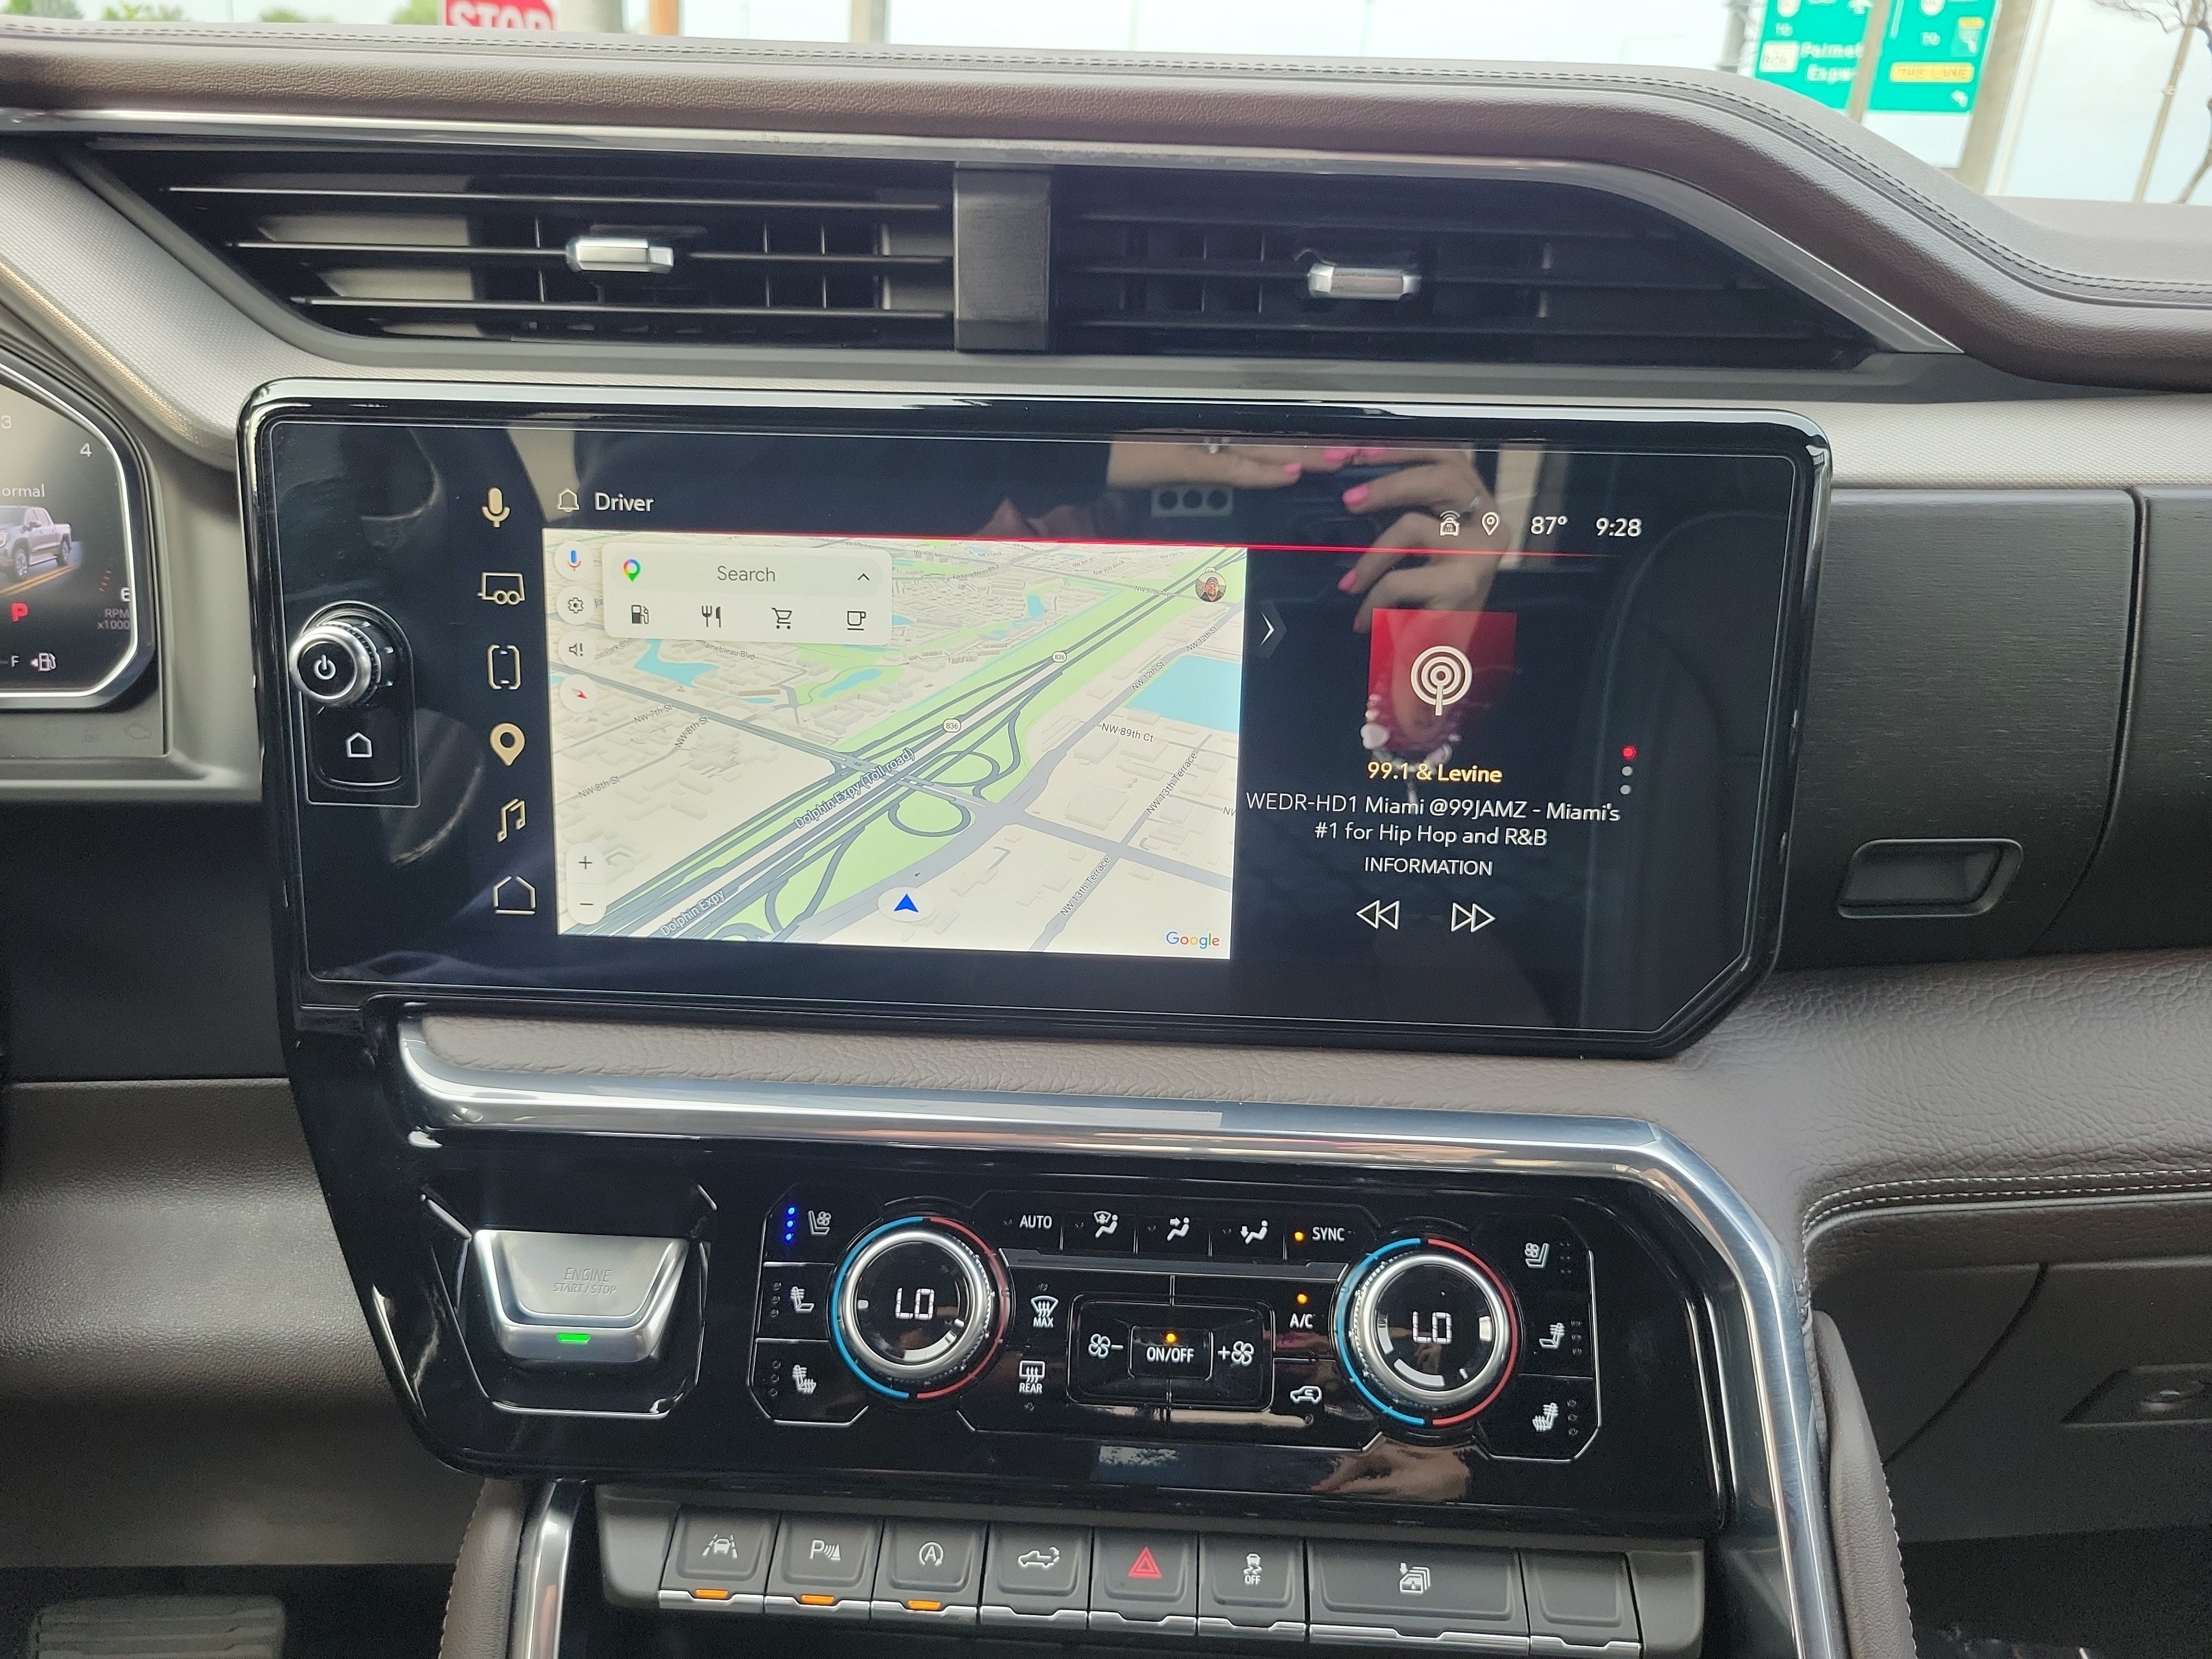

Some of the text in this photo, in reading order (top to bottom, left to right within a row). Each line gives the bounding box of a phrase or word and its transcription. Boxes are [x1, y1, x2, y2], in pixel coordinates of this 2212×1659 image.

[2, 415, 12, 428] 3
[80, 442, 93, 458] 4
[595, 492, 654, 512] Driver
[1595, 517, 1643, 537] 9:28
[717, 565, 776, 582] Search
[12, 602, 29, 622] P
[104, 608, 129, 618] RPM
[1186, 625, 1218, 652] NW 12th St
[11, 655, 20, 668] F
[1131, 661, 1165, 691] NW 12th St
[634, 703, 674, 724] NW 7th St
[675, 716, 709, 748] NW 8th St
[946, 721, 958, 730] 836
[1102, 723, 1154, 742] NW 89th Ct
[1367, 761, 1503, 783] 99.1 & Levine
[579, 775, 620, 799] NW 8th St
[794, 747, 916, 829] Dolphin Expy (Toll road)
[1146, 752, 1197, 814] NW 13th Terrace
[1246, 792, 1357, 813] WEDR-HD1
[1365, 795, 1425, 815] Miami
[1429, 798, 1527, 820] @99JAMZ
[1546, 802, 1620, 822] Miami's
[1314, 821, 1548, 847] #1 for Hip Hop and R&B
[1364, 857, 1493, 876] INFORMATION
[1060, 857, 1110, 916] NW 13th Terrace
[661, 889, 725, 936] Dolphin Expy
[1166, 931, 1220, 949] Google
[1019, 1215, 1052, 1229] AUTO
[1312, 1226, 1346, 1242] SYNC
[564, 1268, 612, 1282] ENGINE
[1032, 1316, 1054, 1328] MAX
[1289, 1314, 1314, 1329] A/C
[1146, 1346, 1195, 1363] ON/OFF
[1019, 1382, 1043, 1393] REAR
[1244, 1575, 1261, 1585] OFF
